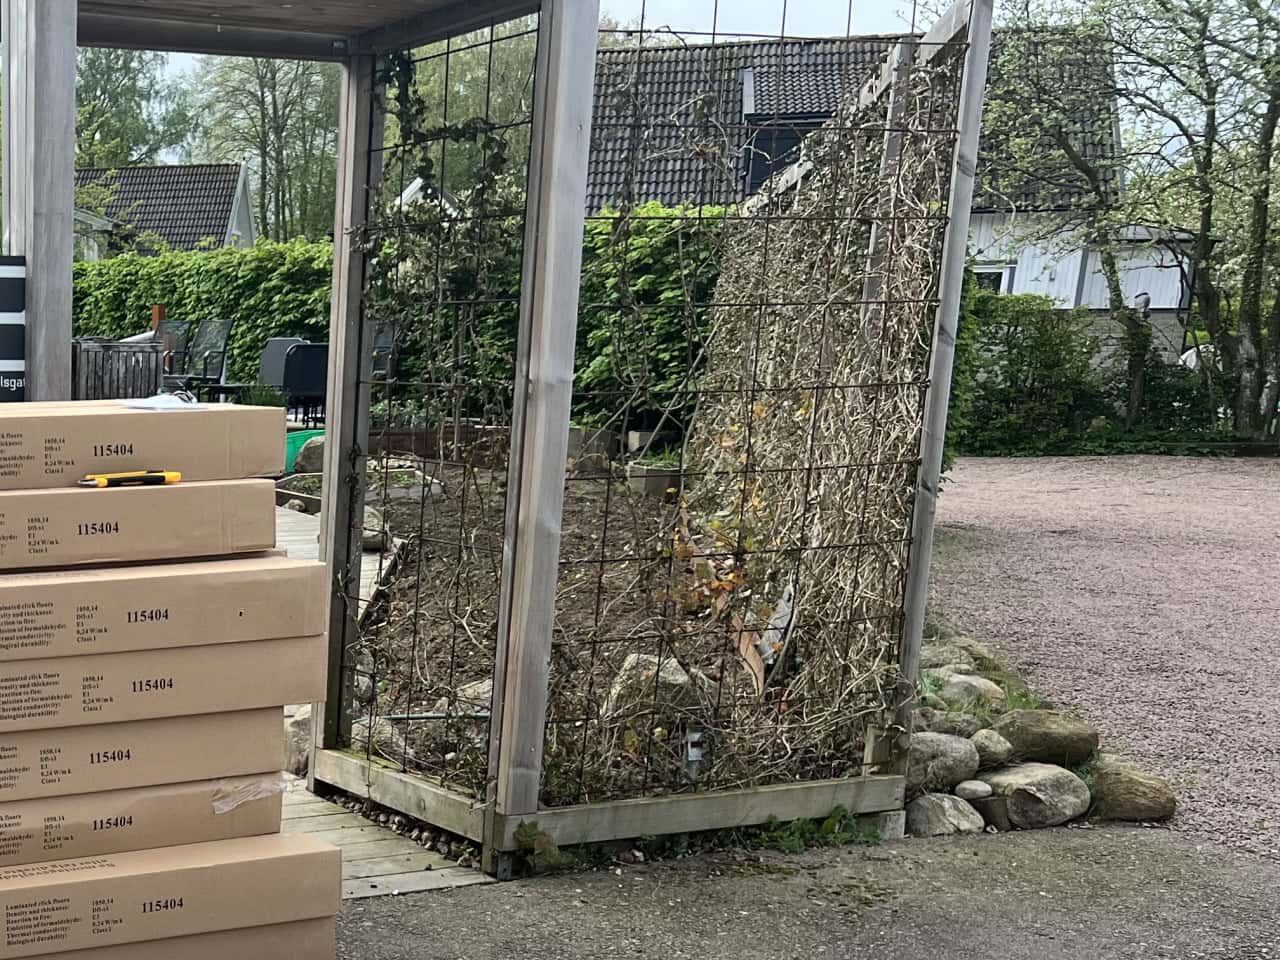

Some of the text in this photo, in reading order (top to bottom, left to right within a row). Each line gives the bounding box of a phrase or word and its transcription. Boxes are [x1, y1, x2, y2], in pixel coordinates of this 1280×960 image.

[93, 443, 134, 457] 115404
[78, 521, 119, 536] 115404
[127, 608, 169, 624] 115404
[132, 677, 173, 693] 115404
[89, 748, 131, 765] 115404
[93, 815, 133, 831] 115404
[142, 897, 184, 914] 115404
